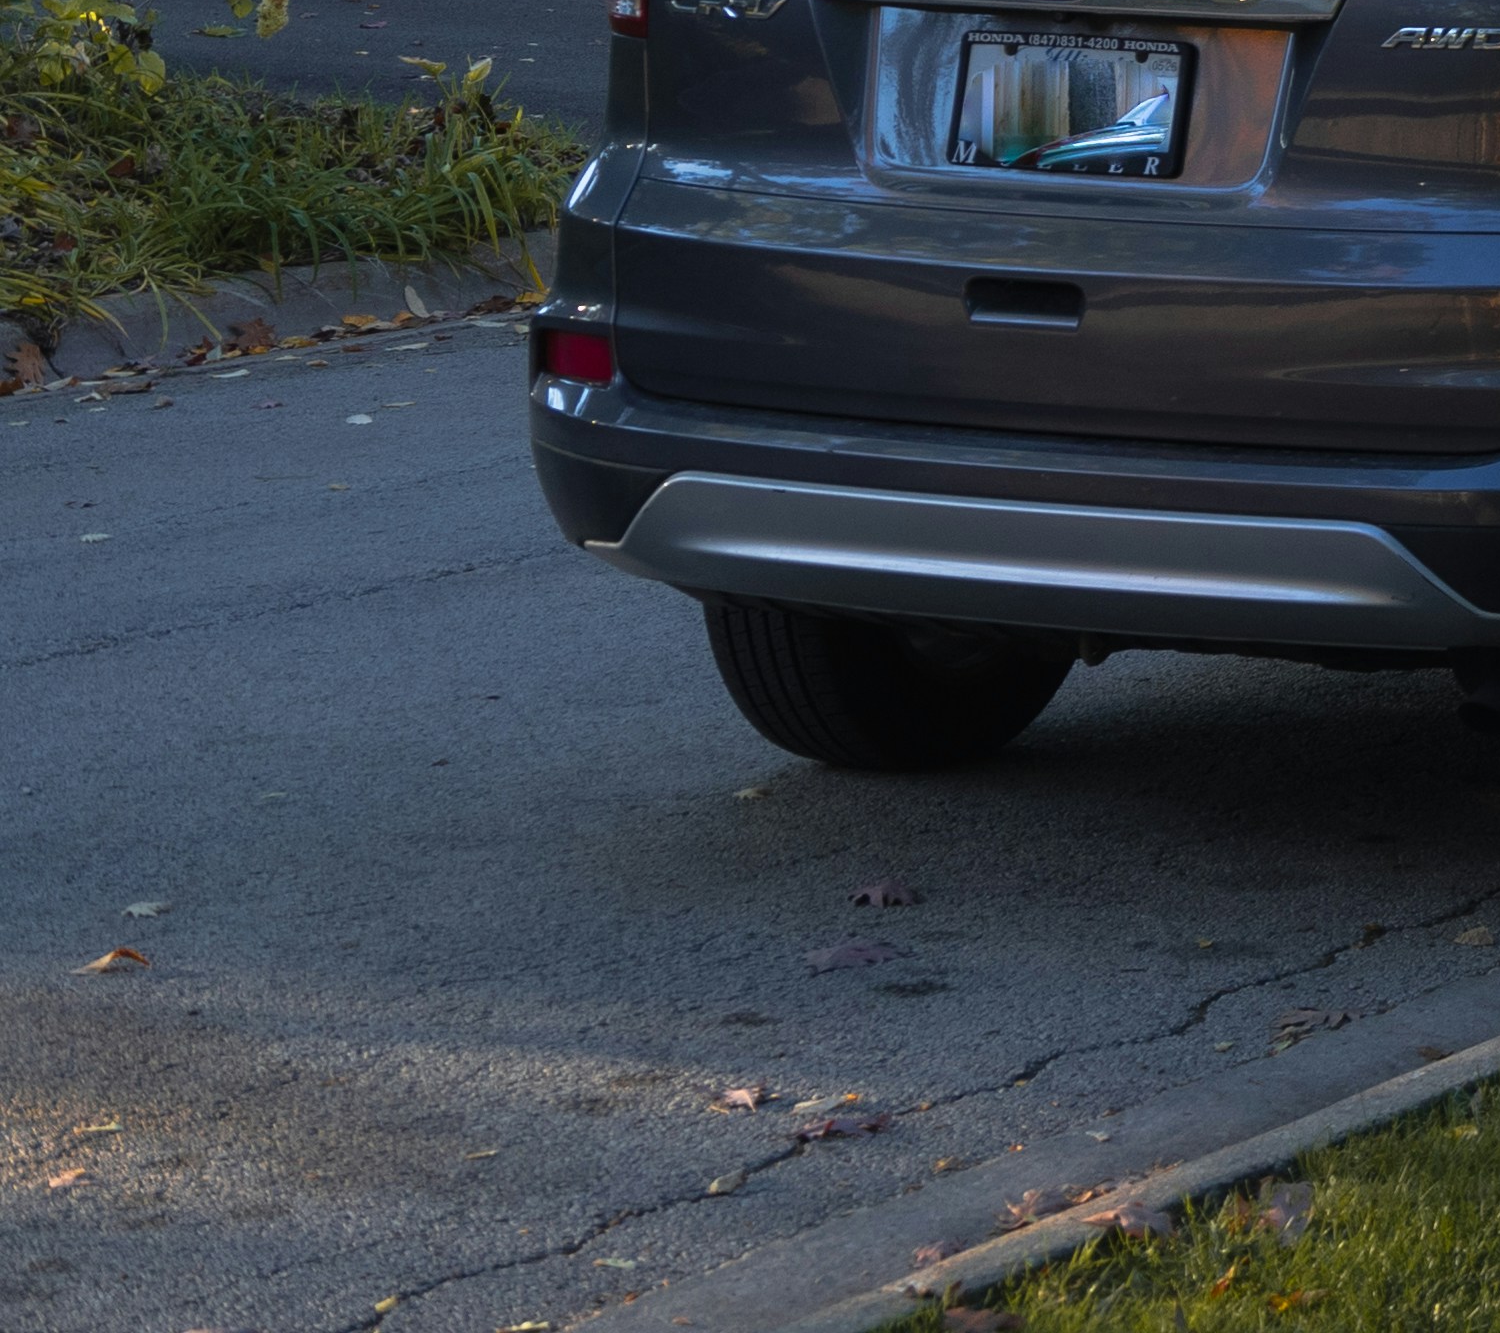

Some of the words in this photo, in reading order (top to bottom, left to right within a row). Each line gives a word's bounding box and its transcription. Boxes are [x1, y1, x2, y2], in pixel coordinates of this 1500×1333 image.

[967, 32, 1026, 44] HONDA
[1028, 34, 1119, 50] (847)831-4200
[1123, 40, 1179, 53] HONDA
